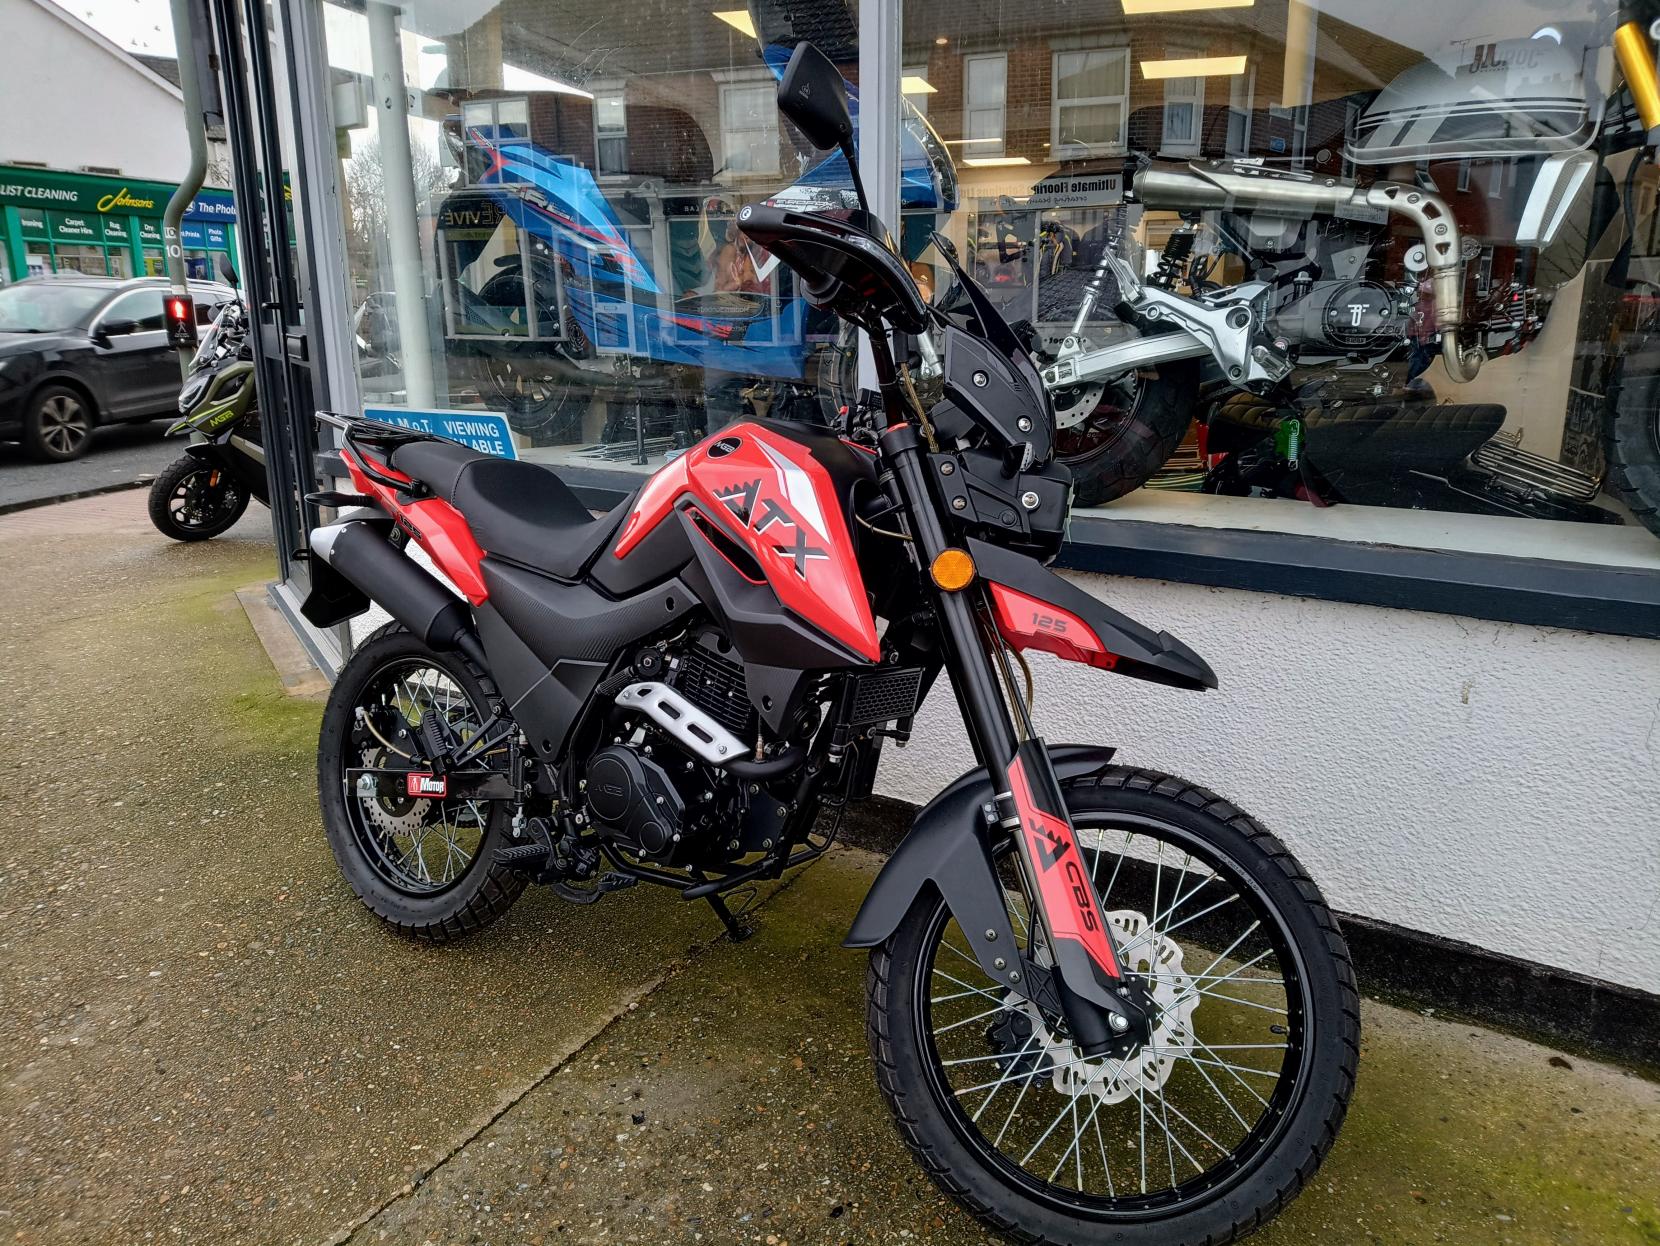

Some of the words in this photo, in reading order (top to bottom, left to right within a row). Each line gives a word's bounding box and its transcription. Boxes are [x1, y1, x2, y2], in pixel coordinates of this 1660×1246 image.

[24, 187, 79, 201] CLEANING
[97, 187, 154, 212] Johnsons
[198, 202, 215, 212] The
[65, 218, 85, 226] Carpet
[144, 223, 154, 231] Dry
[104, 229, 128, 238] Cleaning
[139, 231, 161, 239] Cleaning
[165, 244, 181, 258] 10
[443, 420, 500, 438] VIEWING
[712, 478, 831, 582] ATX
[1032, 612, 1068, 633] 125
[1065, 861, 1100, 932] CBS
